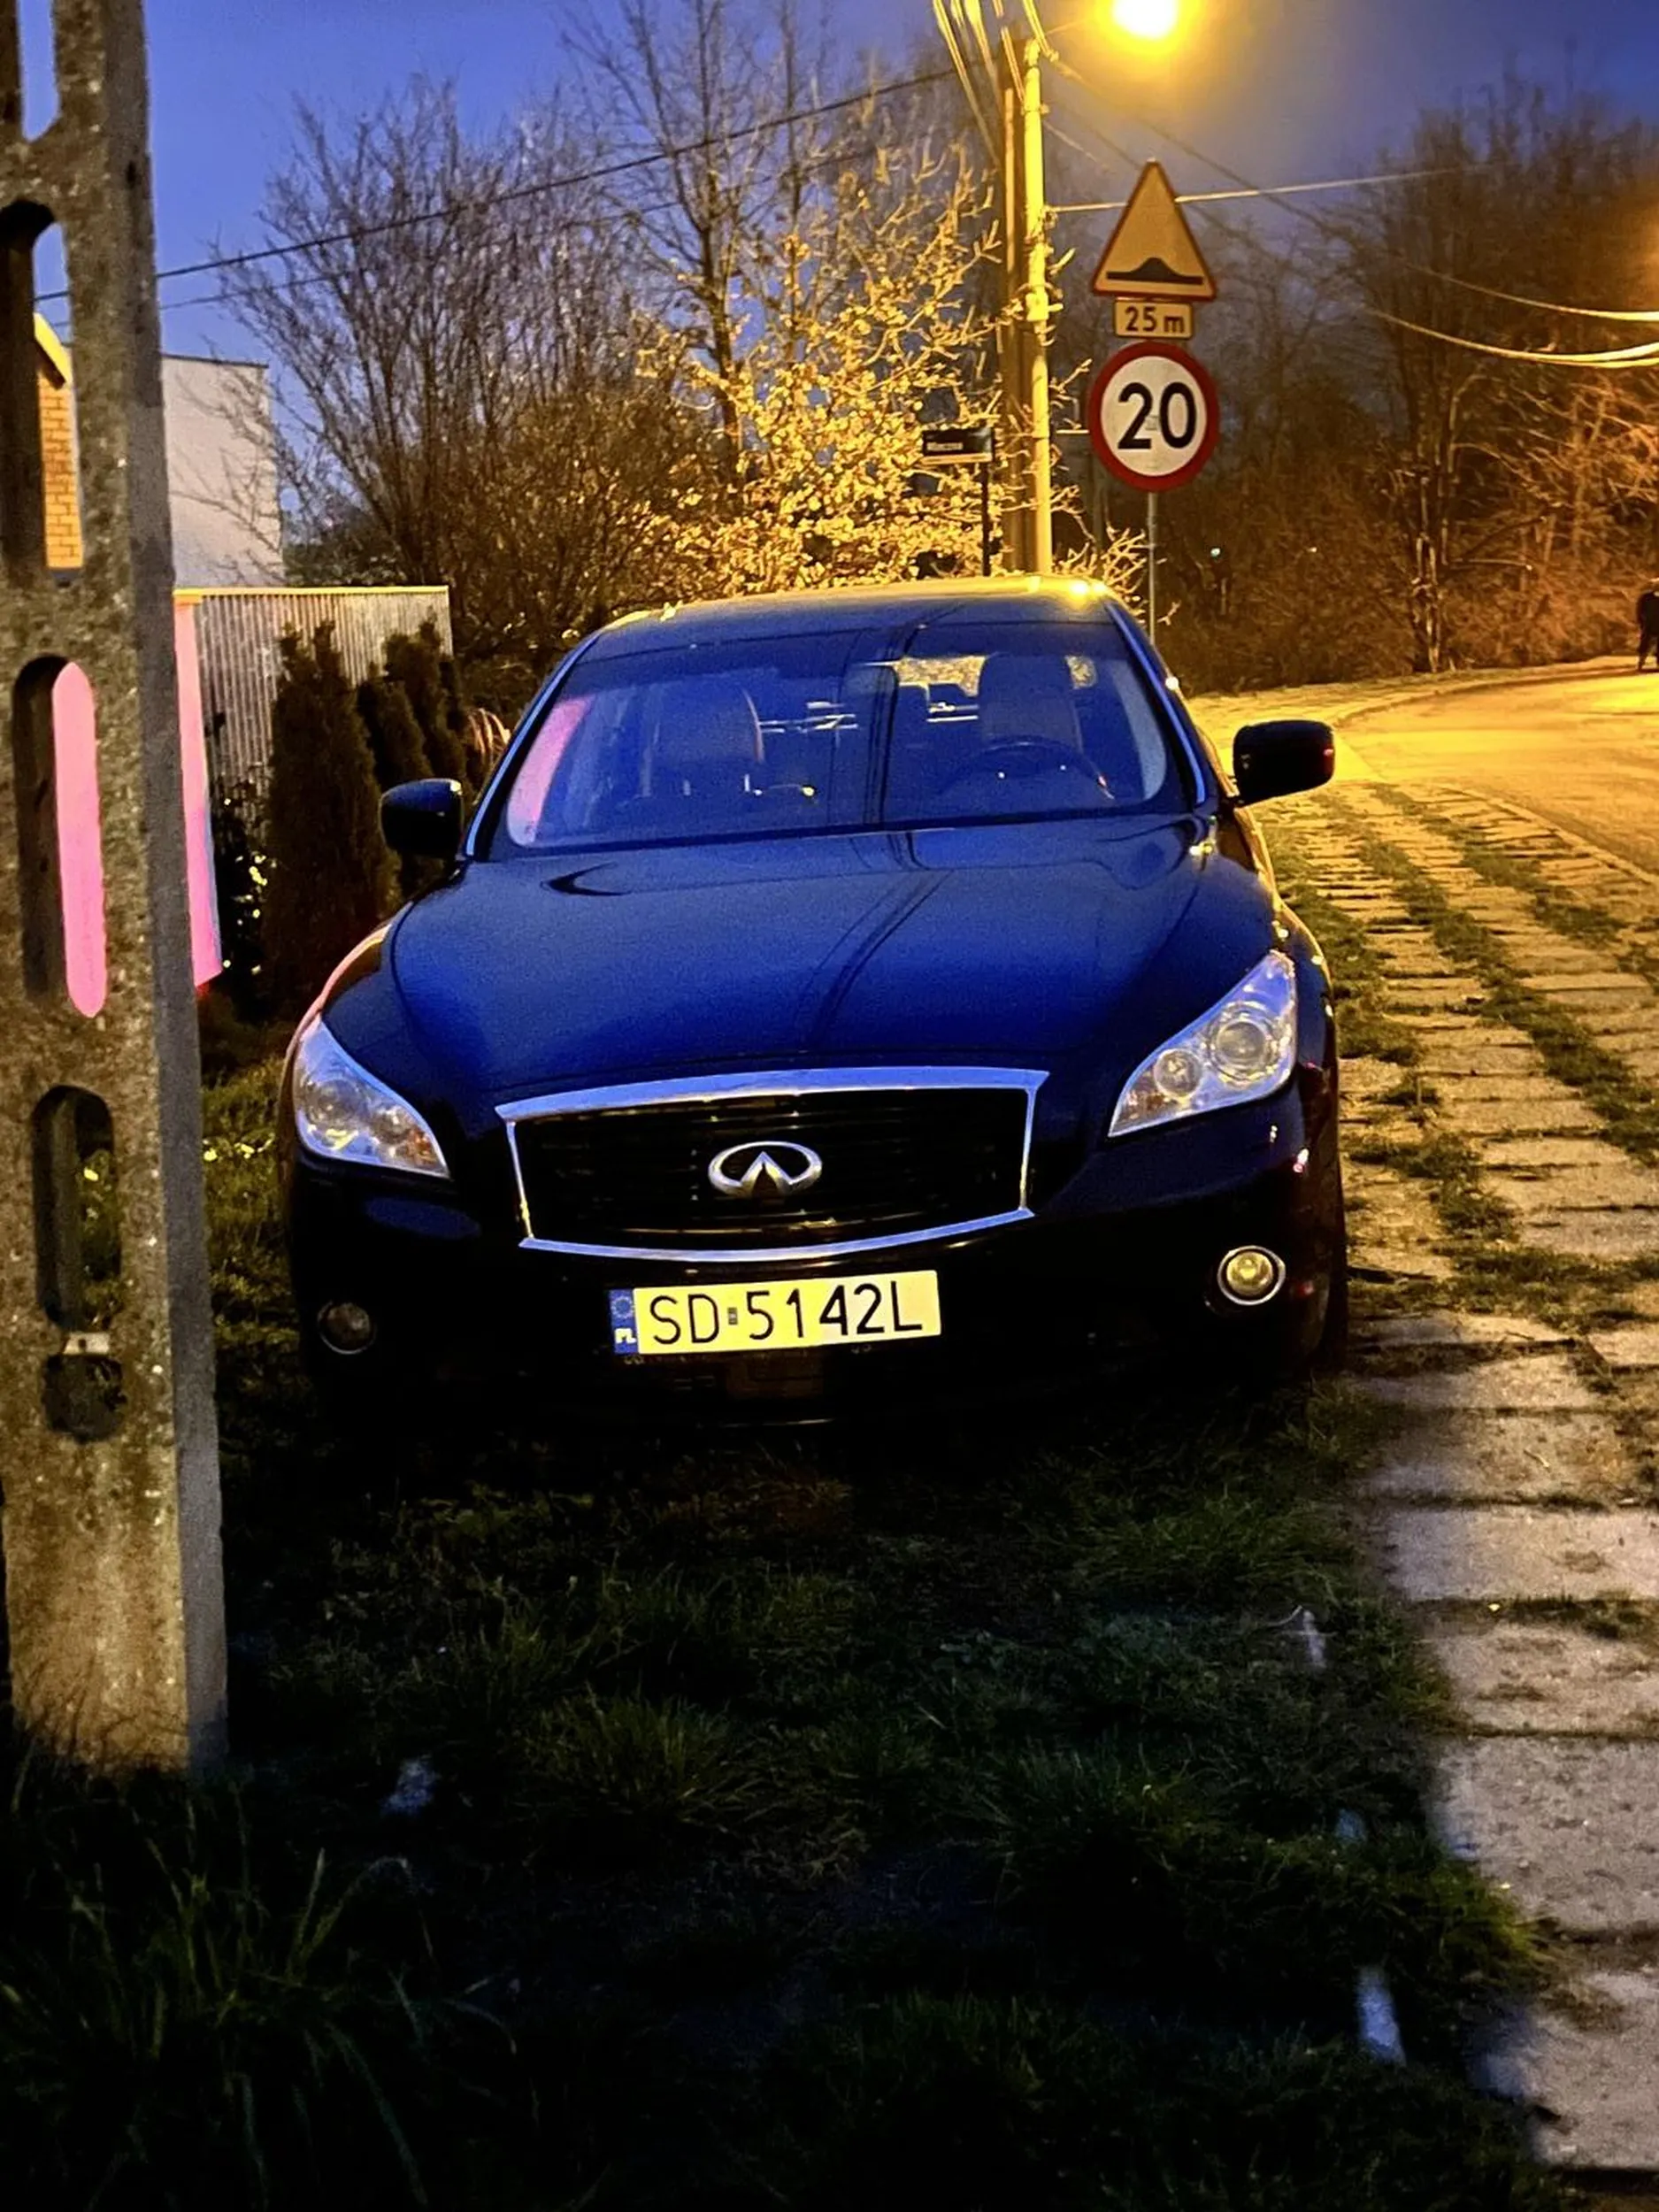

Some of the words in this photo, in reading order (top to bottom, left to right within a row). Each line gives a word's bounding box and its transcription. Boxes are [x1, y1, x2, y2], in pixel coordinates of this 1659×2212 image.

[1125, 306, 1156, 332] 25
[1164, 314, 1185, 334] m
[1118, 381, 1197, 449] 20
[649, 1294, 720, 1345] SD
[746, 1280, 924, 1340] 5142L
